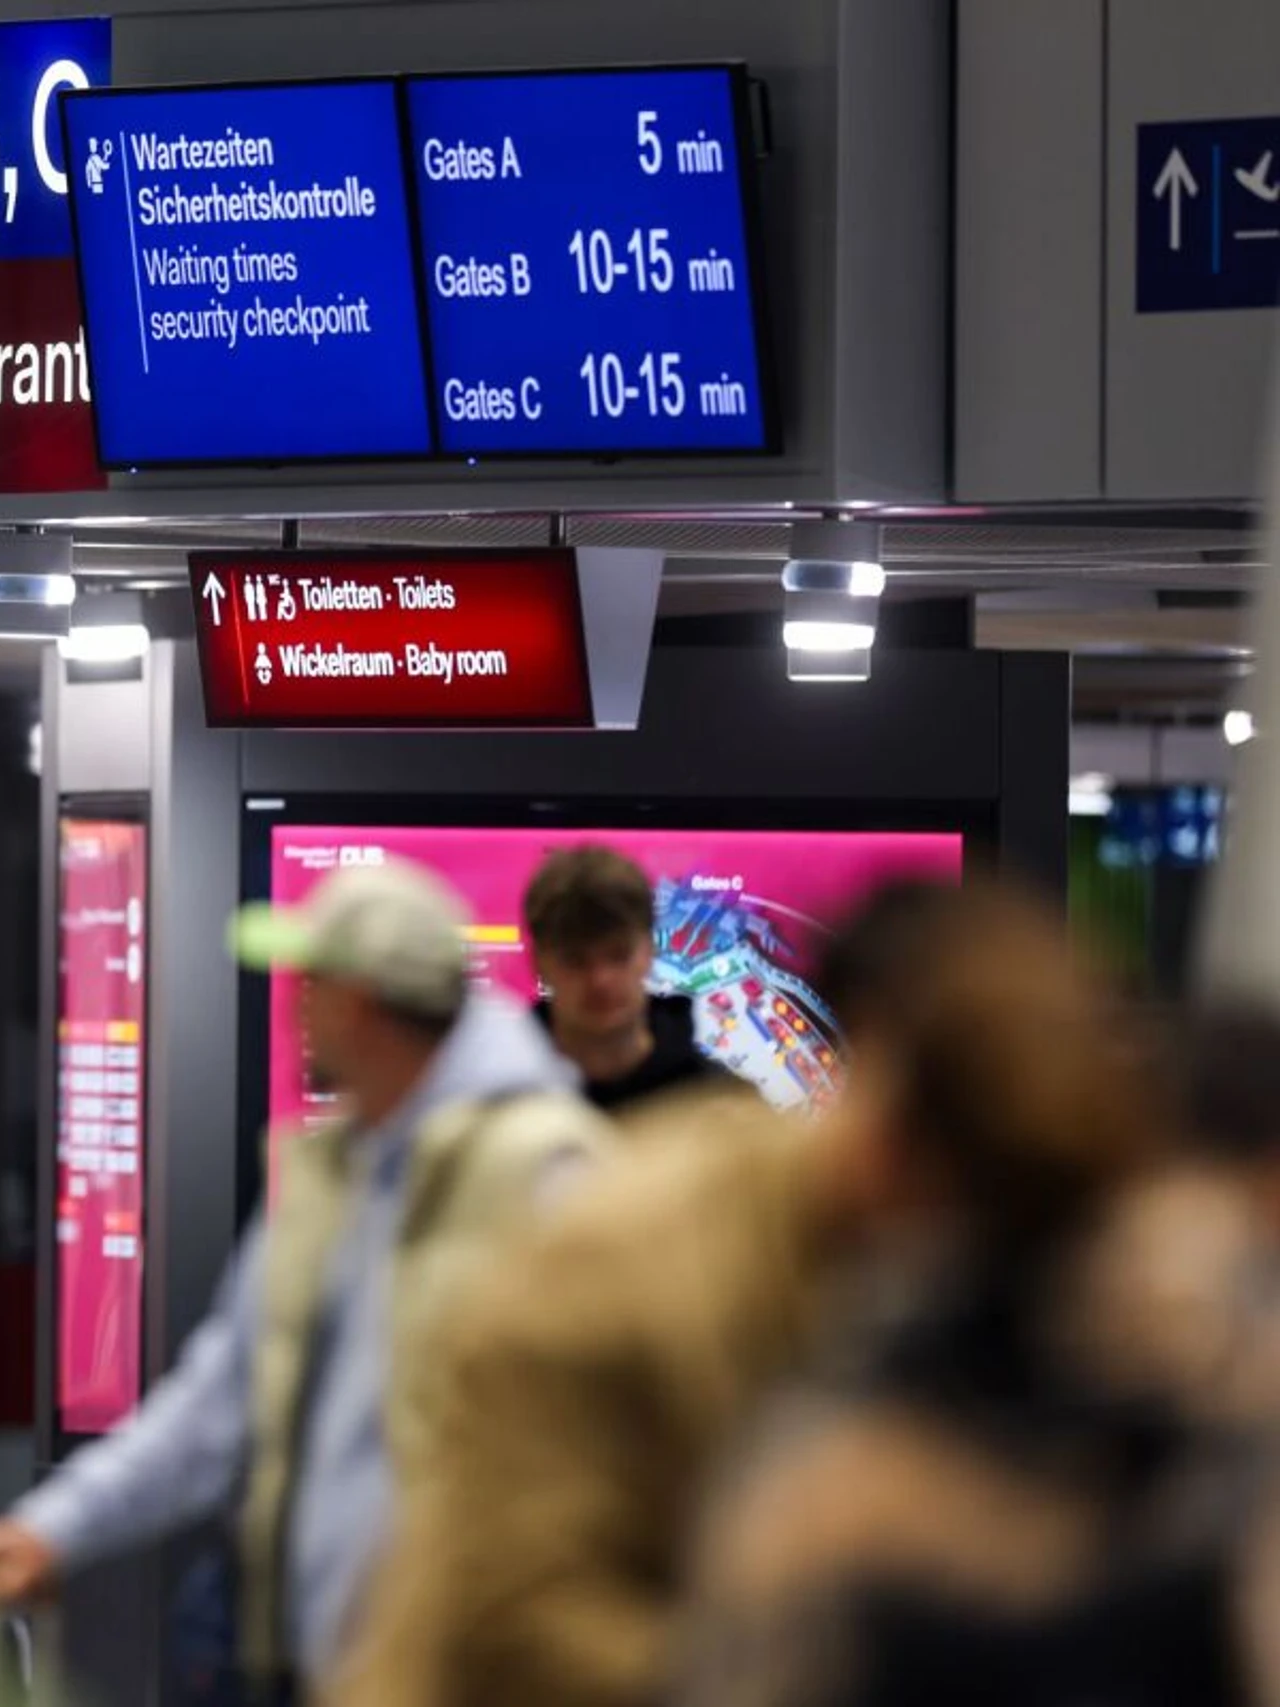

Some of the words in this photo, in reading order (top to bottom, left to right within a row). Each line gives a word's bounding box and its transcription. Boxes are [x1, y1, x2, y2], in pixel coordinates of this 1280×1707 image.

[130, 127, 274, 171] Wartezeiten
[424, 138, 496, 181] Gates
[501, 135, 523, 179] A
[637, 110, 663, 176] 5
[676, 129, 724, 173] min
[137, 175, 377, 226] Sicherheitskontrolle
[142, 243, 231, 295] Waiting
[232, 242, 299, 283] times
[435, 254, 507, 298] Gates
[510, 252, 532, 297] B
[568, 227, 674, 295] 10-15
[687, 247, 735, 293] min
[150, 298, 239, 349] security
[242, 291, 372, 346] checkpoint
[444, 378, 516, 421] Gates
[520, 376, 544, 421] C
[579, 351, 687, 418] 10-15
[699, 372, 747, 416] min
[297, 576, 383, 610] Toiletten
[392, 576, 456, 609] Toilets
[278, 642, 396, 678] Wickelraum
[405, 642, 454, 684] Baby
[455, 649, 508, 676] room
